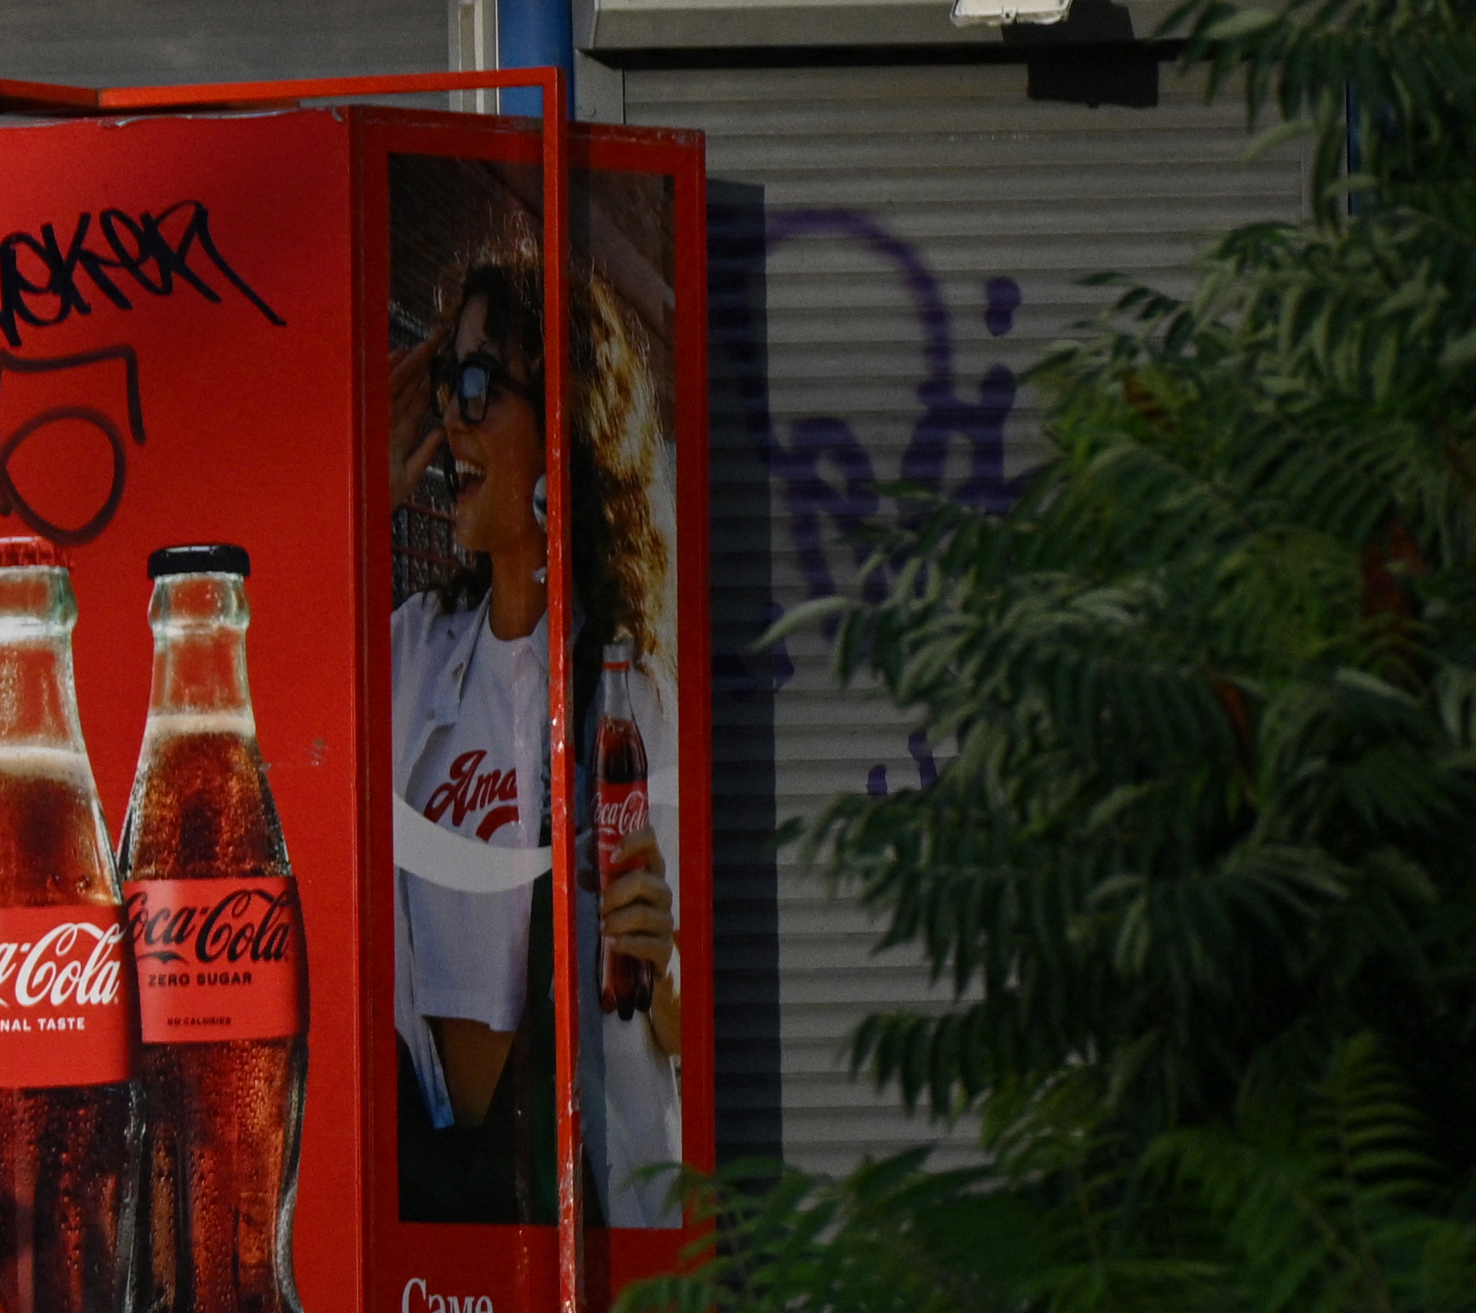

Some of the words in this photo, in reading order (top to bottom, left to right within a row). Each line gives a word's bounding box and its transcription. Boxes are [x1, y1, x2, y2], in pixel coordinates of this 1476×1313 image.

[125, 889, 292, 965] Coca-Cola
[148, 973, 190, 987] ZERO
[197, 972, 254, 986] SUGAR
[37, 1015, 86, 1031] TASTE
